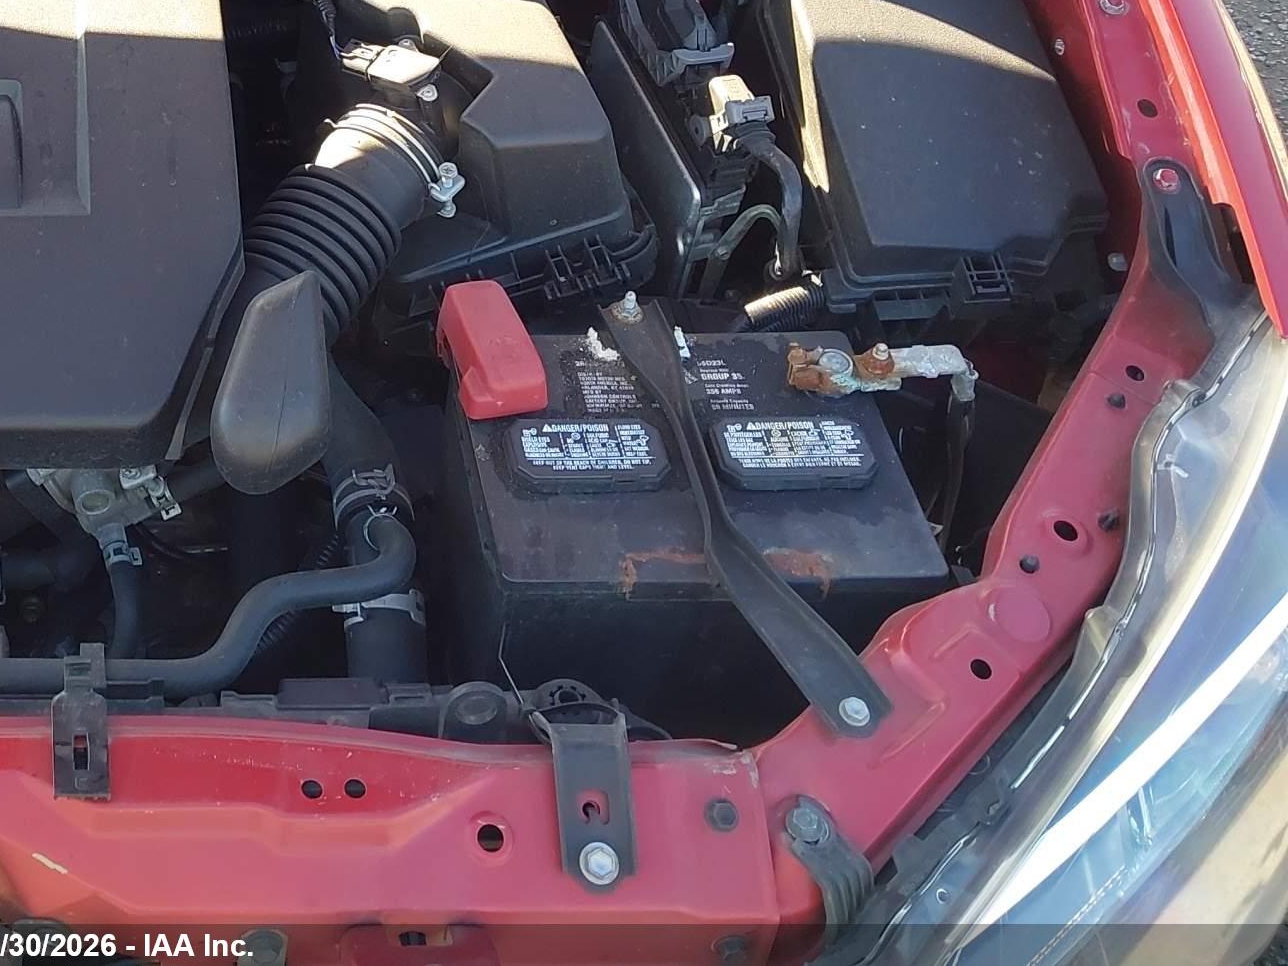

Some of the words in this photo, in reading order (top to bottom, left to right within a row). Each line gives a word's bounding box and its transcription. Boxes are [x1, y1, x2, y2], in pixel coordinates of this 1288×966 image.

[700, 372, 730, 381] GROUP
[551, 423, 609, 433] DANGER/POISON
[754, 421, 815, 431] DANGER/POISON
